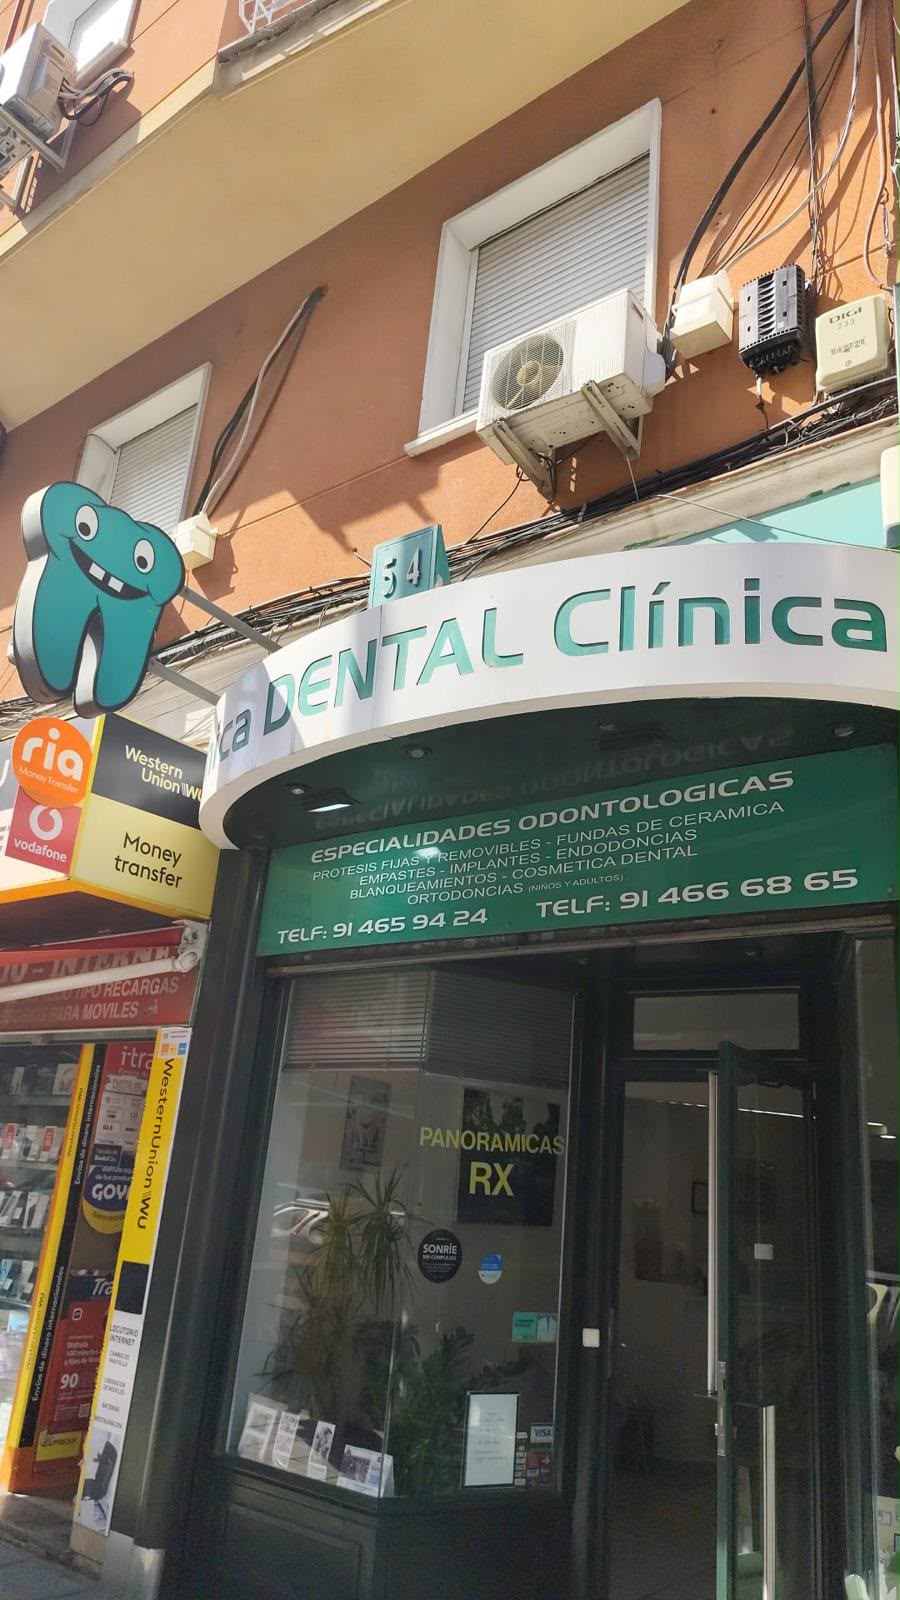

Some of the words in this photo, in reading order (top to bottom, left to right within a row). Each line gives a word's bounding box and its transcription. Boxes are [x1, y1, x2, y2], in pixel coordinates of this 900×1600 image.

[382, 547, 422, 598] 54
[216, 710, 252, 761] ca
[263, 607, 524, 736] DENTAL
[554, 578, 887, 656] Clínica
[21, 728, 84, 781] ria
[125, 744, 183, 779] Western
[19, 766, 48, 783] Money
[47, 775, 80, 794] Transfer
[141, 767, 181, 794] Union
[311, 819, 511, 864] ESPECIALIDADES
[518, 770, 794, 831] ODONTOLOGICAS
[14, 838, 68, 863] vodafone
[123, 832, 183, 869] Money
[312, 862, 377, 881] PROTESIS
[381, 856, 420, 871] FIJAS
[438, 837, 541, 863] REMOVIBLES
[556, 824, 630, 846] FUNDAS
[636, 819, 663, 832] DE
[669, 801, 785, 828] CERAMICA
[360, 867, 436, 886] EMPASTES
[450, 852, 541, 875] IMPLANTES
[556, 829, 697, 860] ENDODONCIAS
[115, 855, 183, 888] transfer
[350, 873, 497, 900] BLANQUEAMIENTOS
[512, 855, 615, 881] COSMETICA
[621, 845, 698, 866] DENTAL
[407, 882, 524, 905] ORTODONCIAS
[536, 896, 610, 918] TELF:
[619, 890, 648, 909] 91
[658, 882, 729, 905] 466
[740, 875, 792, 897] 68
[804, 868, 858, 891] 65
[278, 926, 328, 944] TELF:
[333, 922, 353, 938] 91
[358, 916, 406, 934] 465
[412, 912, 446, 930] 94
[453, 908, 488, 926] 24
[104, 976, 180, 998] RECARGAS
[81, 1002, 140, 1020] MOVILES
[419, 1126, 565, 1155] PANORAMICAS
[92, 1184, 129, 1200] GOY
[469, 1161, 514, 1197] RX
[137, 1197, 150, 1230] WU
[41, 1331, 51, 1358] dinero
[60, 1373, 79, 1389] 90
[535, 1428, 551, 1438] VISA
